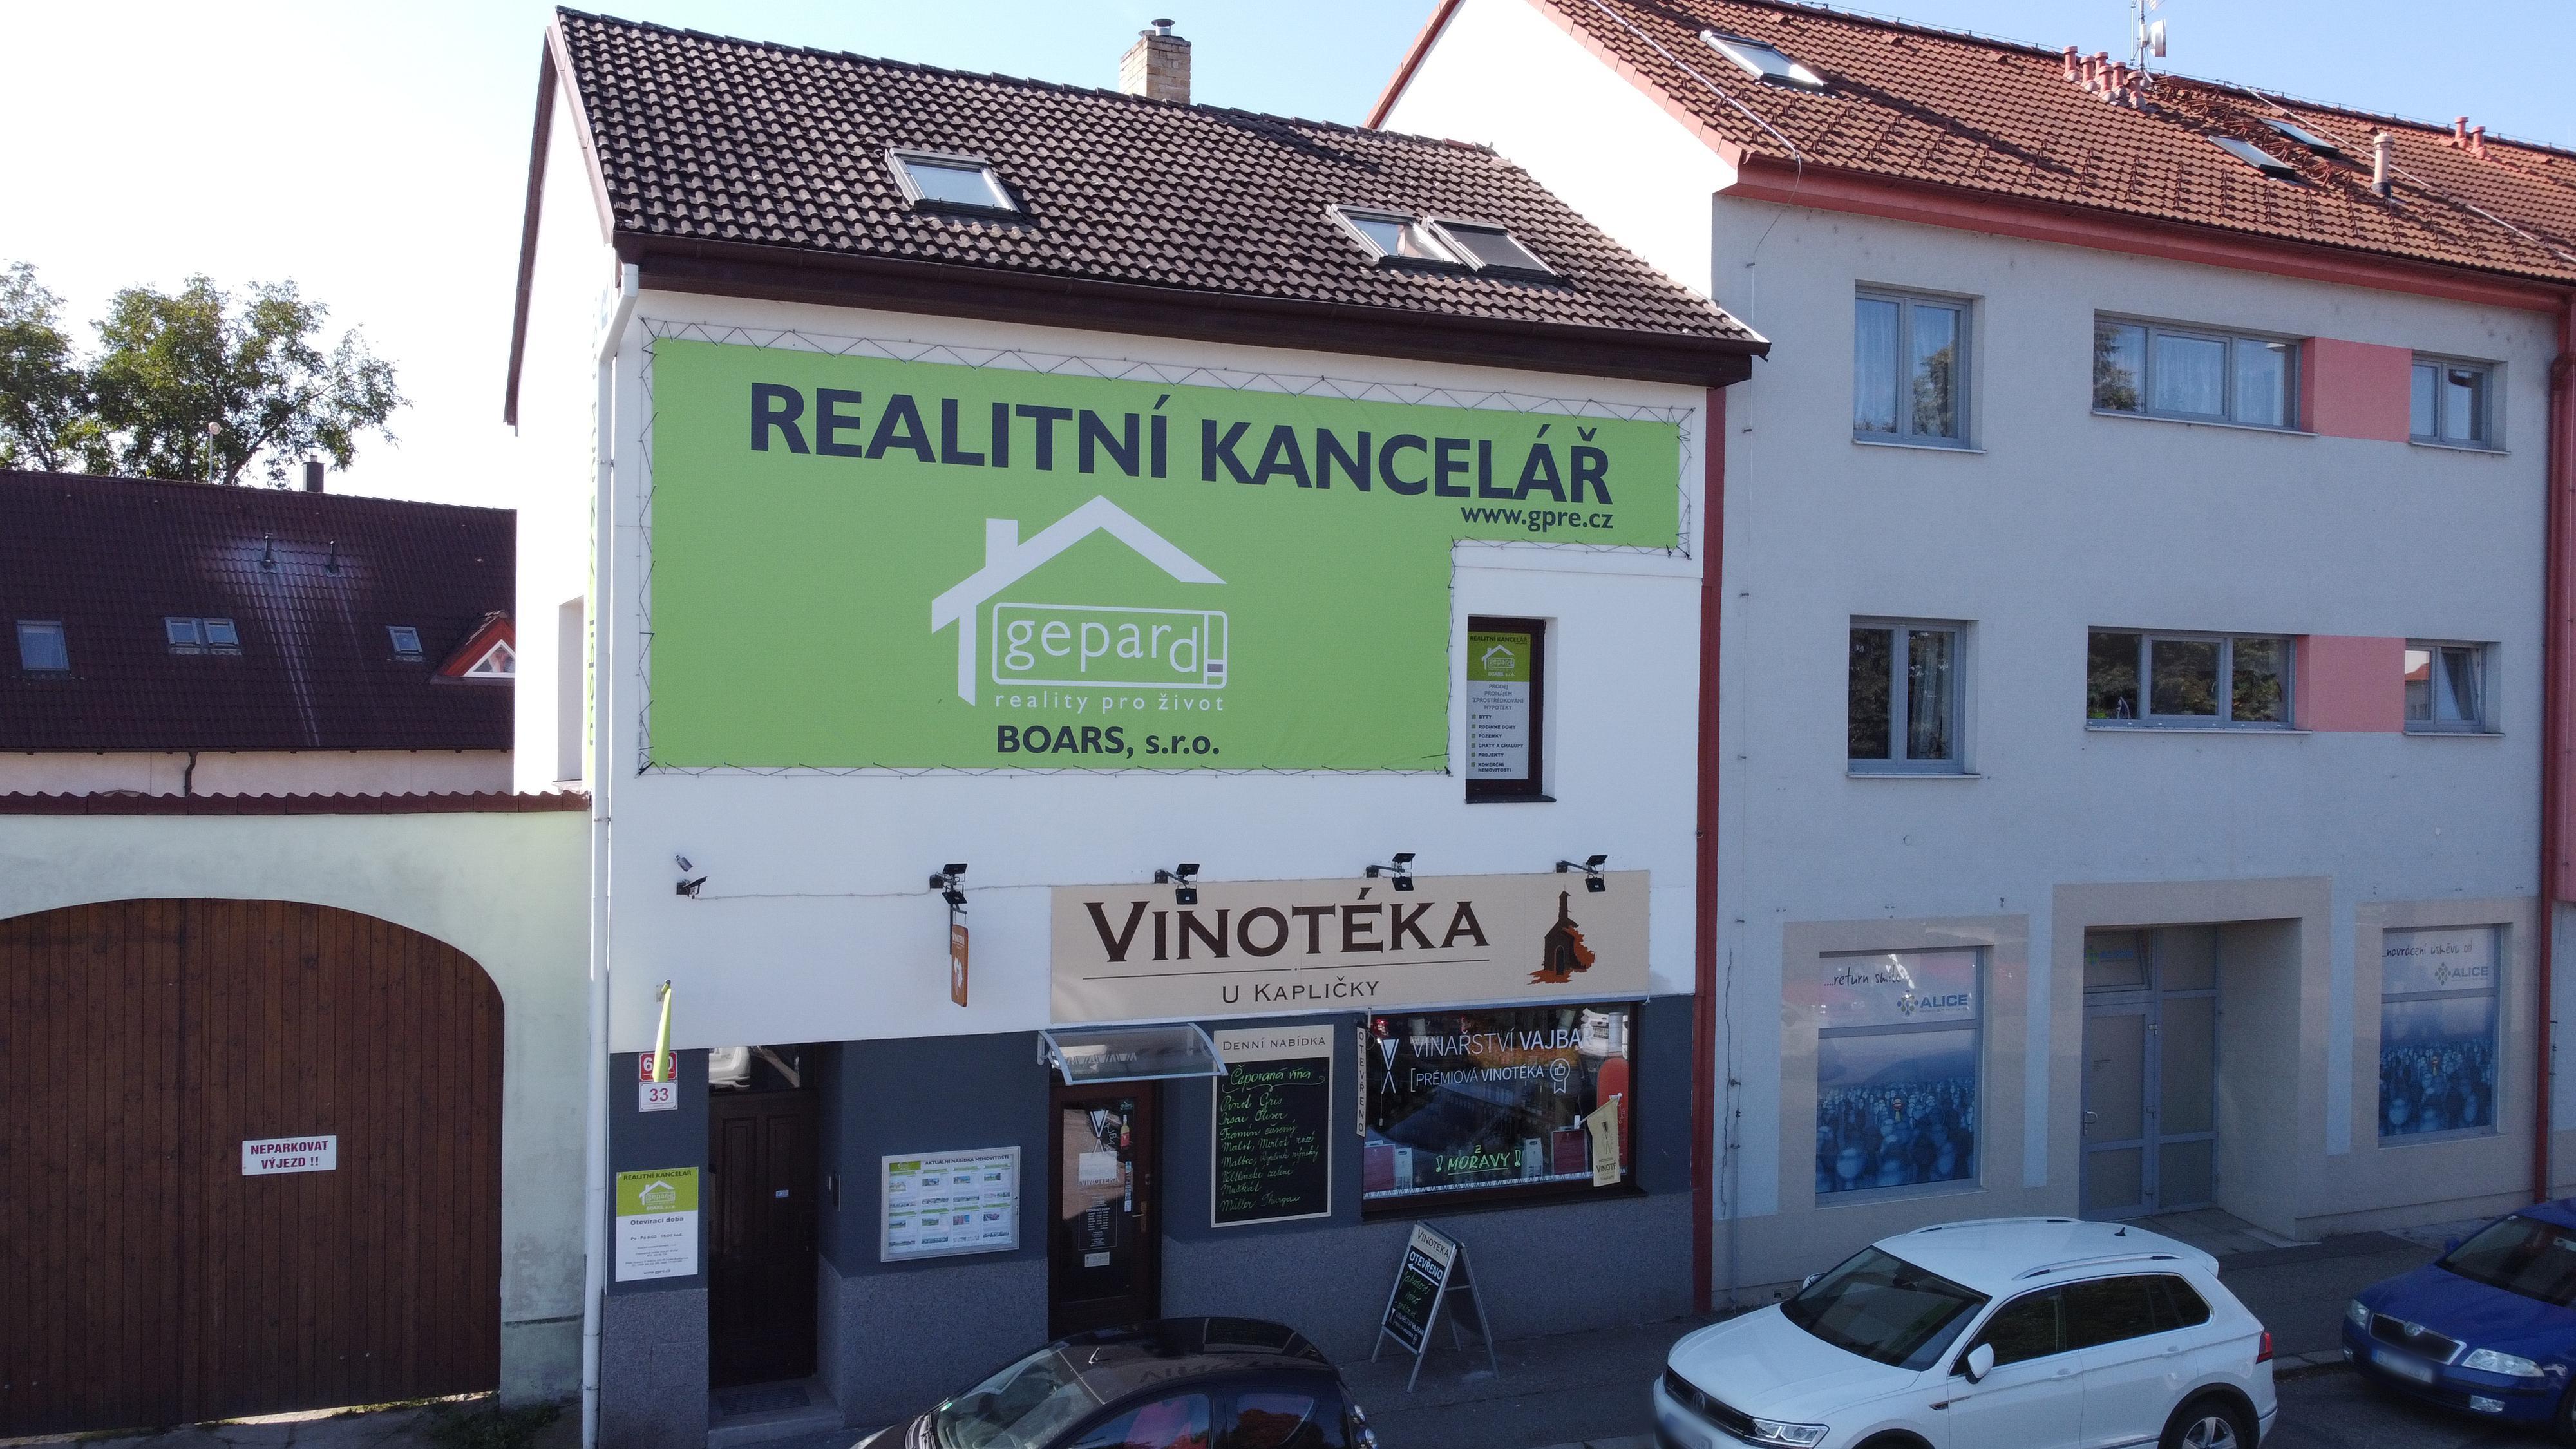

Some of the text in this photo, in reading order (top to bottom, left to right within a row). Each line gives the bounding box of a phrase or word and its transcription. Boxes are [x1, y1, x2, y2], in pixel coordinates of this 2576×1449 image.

[751, 383, 1613, 505] REALITNÍ KANCELÁŘ
[1460, 507, 1613, 533] www.gpre.cz
[995, 691, 1224, 714] reality pro život
[998, 725, 1220, 759] BOARS, s.r.o.
[1083, 887, 1490, 962] VINOTÉKA
[2452, 967, 2489, 978] ALICE
[1222, 976, 1380, 1005] U KAPLIČKY
[1920, 994, 1969, 1008] ALICE
[1223, 1035, 1326, 1051] DENNÍ NABÍDKA
[1410, 1028, 1515, 1057] VINAŘSTVÍ
[643, 1056, 674, 1072] 60
[1481, 1064, 1544, 1082] VINOTÉKA
[649, 1088, 669, 1102] 33
[1220, 1092, 1283, 1112] Pinot Gris
[1255, 1110, 1288, 1121] Oliver
[251, 1141, 328, 1155] NEPARKOVAT
[1258, 1137, 1289, 1150] Merlot
[261, 1157, 319, 1170] VÝJEZD !!
[1448, 1152, 1510, 1170] MORAVY
[623, 1172, 654, 1180] REALITNÍ
[1220, 1191, 1300, 1211] Müller Thurgau
[1417, 1229, 1449, 1258] VINOTÉKA
[1409, 1251, 1443, 1280] OTEVŘENO
